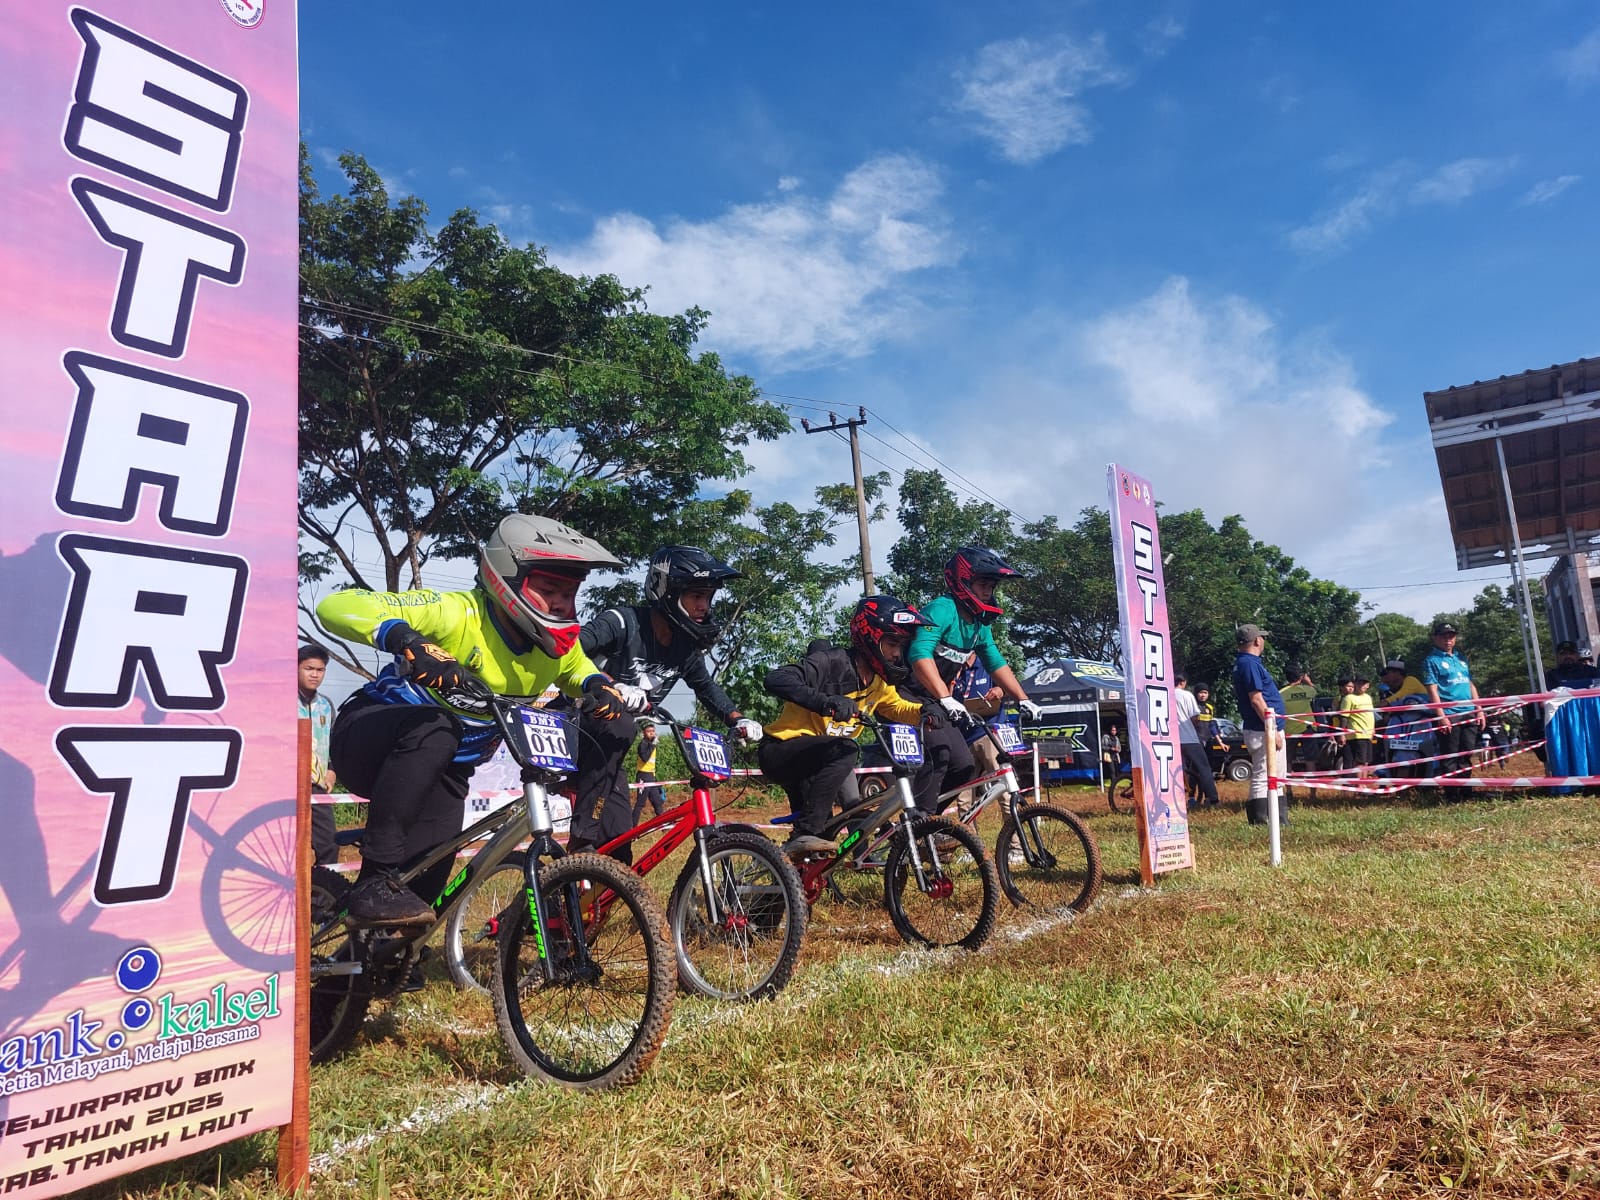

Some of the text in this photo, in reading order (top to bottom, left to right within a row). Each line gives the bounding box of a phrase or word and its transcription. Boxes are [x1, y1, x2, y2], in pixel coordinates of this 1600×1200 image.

[50, 7, 249, 904] START
[1131, 520, 1174, 793] START
[529, 715, 557, 727] BMX
[531, 733, 570, 756] 010
[895, 739, 917, 754] 005
[699, 747, 725, 765] 009
[159, 974, 281, 1040] kalsel
[46, 1050, 132, 1083] Melayani,
[137, 1040, 190, 1061] Melaju
[195, 1025, 259, 1047] Bersama
[0, 1059, 255, 1138] EJURPROV BMX
[22, 1091, 224, 1159] TAHUN 2025
[180, 1107, 254, 1142] LAUT
